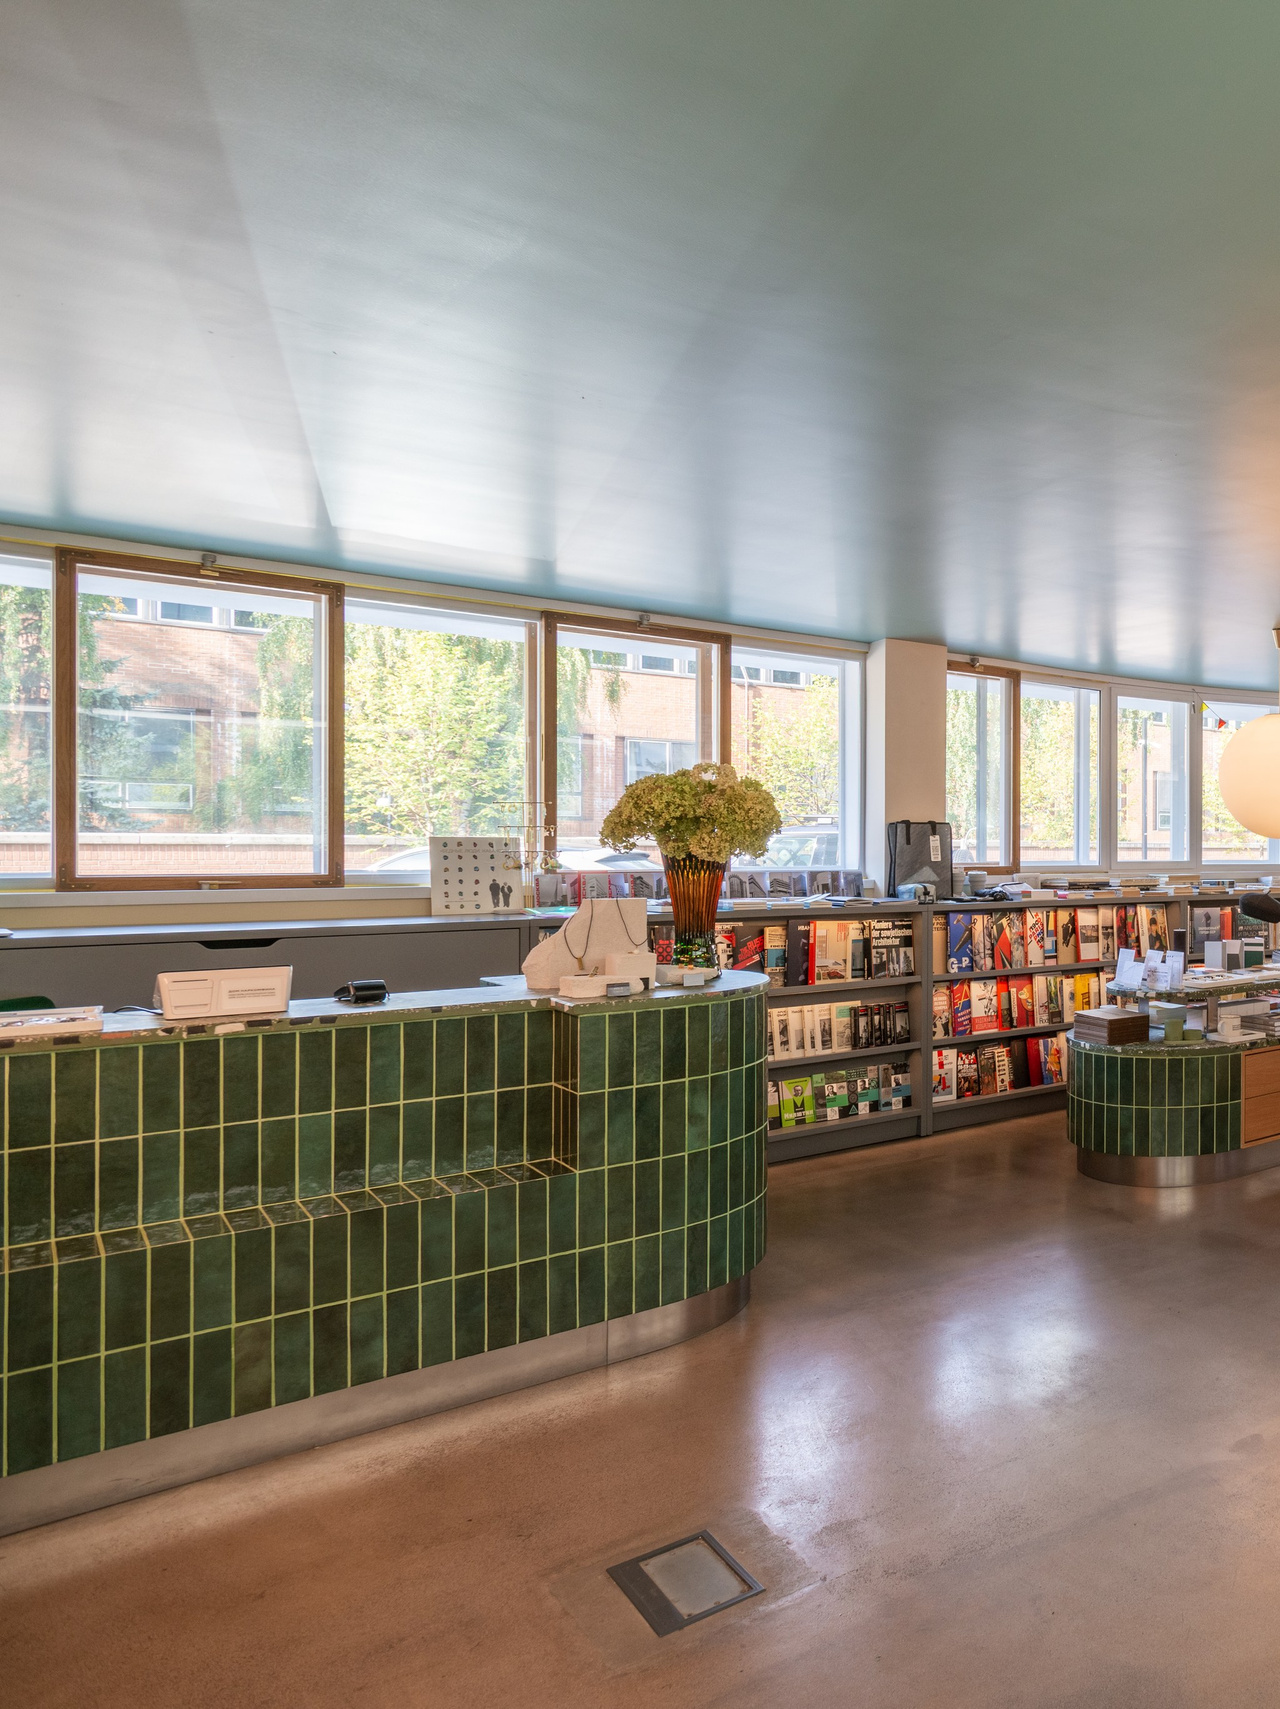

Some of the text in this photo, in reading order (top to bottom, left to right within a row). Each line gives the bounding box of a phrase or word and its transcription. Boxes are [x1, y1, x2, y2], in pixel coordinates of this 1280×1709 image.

[872, 920, 893, 929] Pioniere
[881, 928, 912, 938] sowjetischen
[872, 938, 900, 946] Architektur
